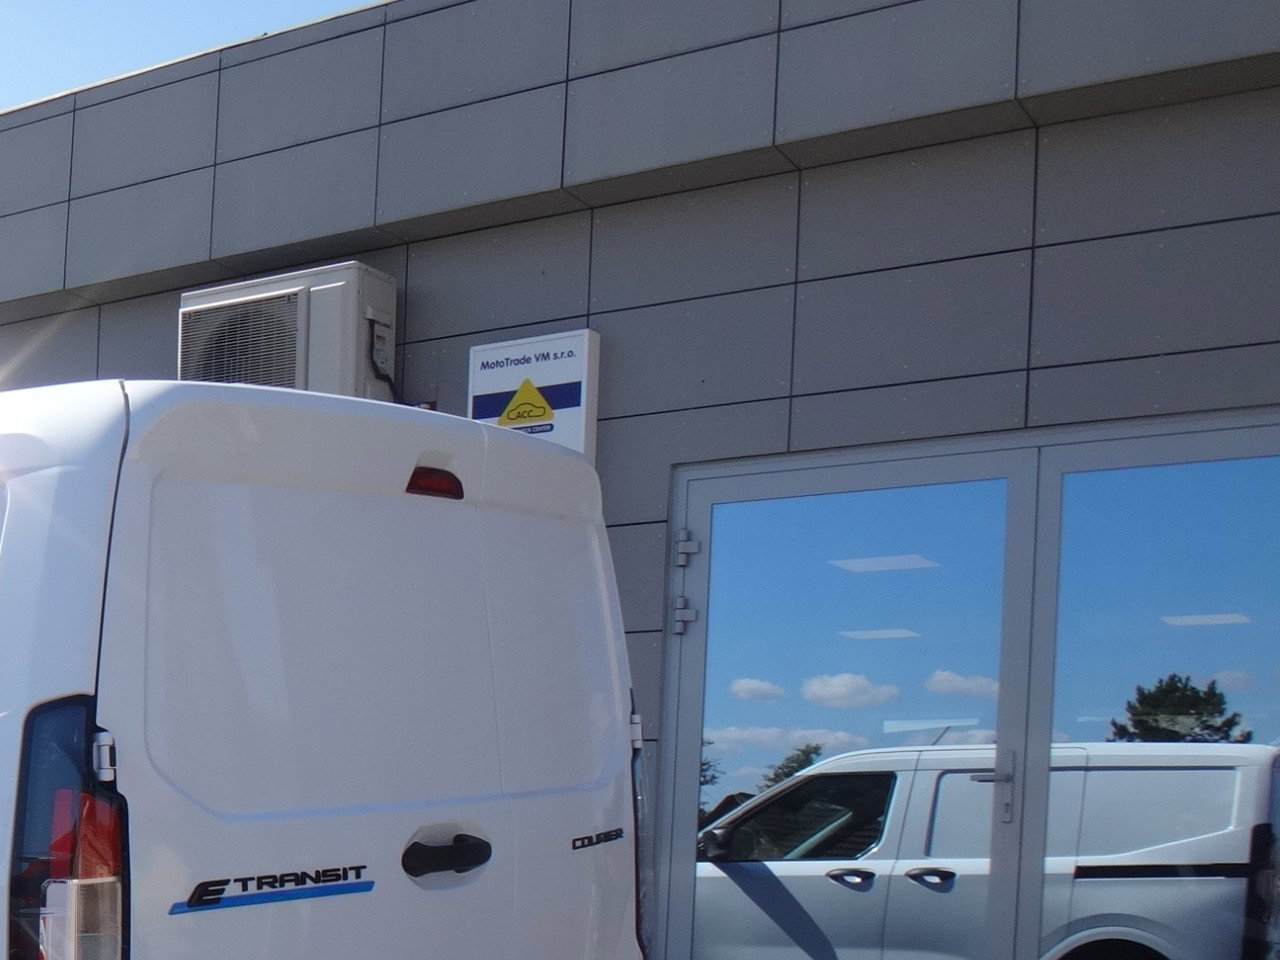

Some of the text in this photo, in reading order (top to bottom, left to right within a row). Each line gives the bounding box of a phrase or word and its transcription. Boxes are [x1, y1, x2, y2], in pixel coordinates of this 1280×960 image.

[480, 350, 577, 371] MotoTrade VM s.r.o.
[516, 409, 534, 419] ACC
[234, 865, 367, 892] TRANSIT
